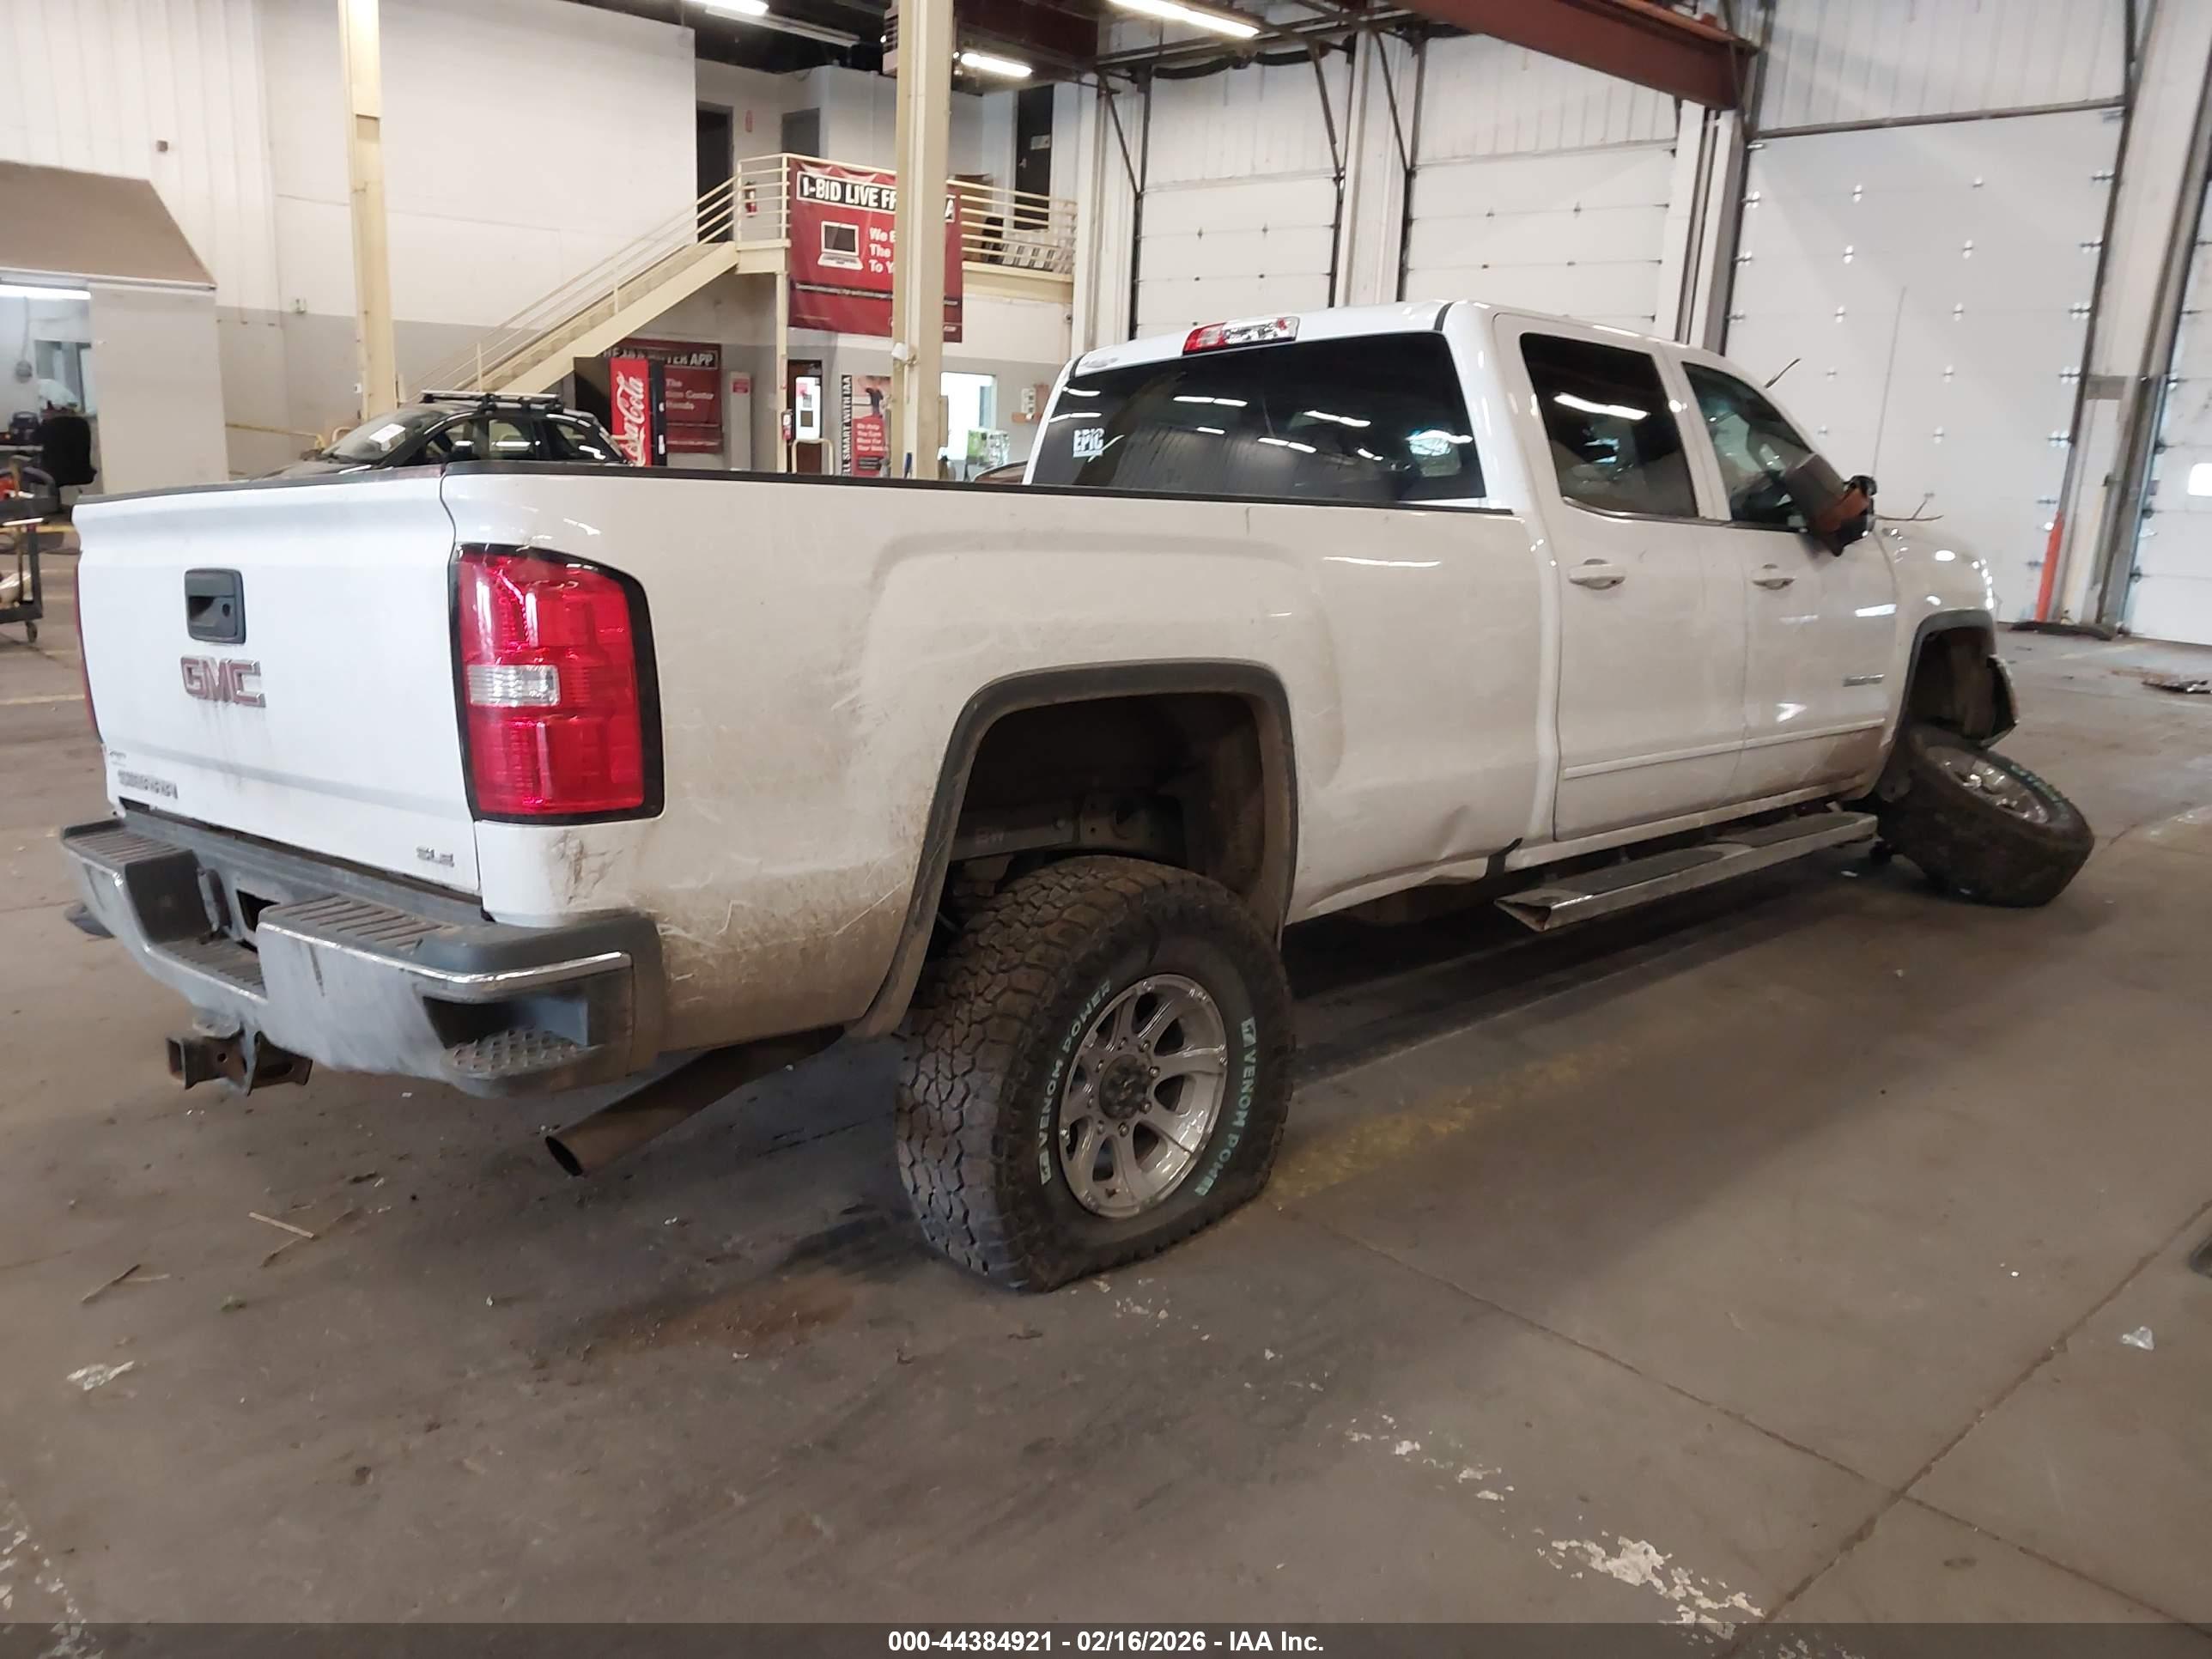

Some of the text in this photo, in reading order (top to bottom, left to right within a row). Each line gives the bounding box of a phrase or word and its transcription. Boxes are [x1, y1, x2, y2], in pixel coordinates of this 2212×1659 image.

[803, 176, 842, 201] I-BID
[845, 183, 878, 207] LIVE
[869, 227, 888, 241] We
[869, 243, 891, 258] The
[868, 258, 884, 273] To
[690, 353, 714, 366] APP
[1073, 428, 1104, 453] EPIC
[180, 655, 266, 708] GMC
[416, 846, 454, 868] SLE
[1039, 981, 1111, 1148] VENOM POWER
[1232, 1049, 1257, 1127] VENOM
